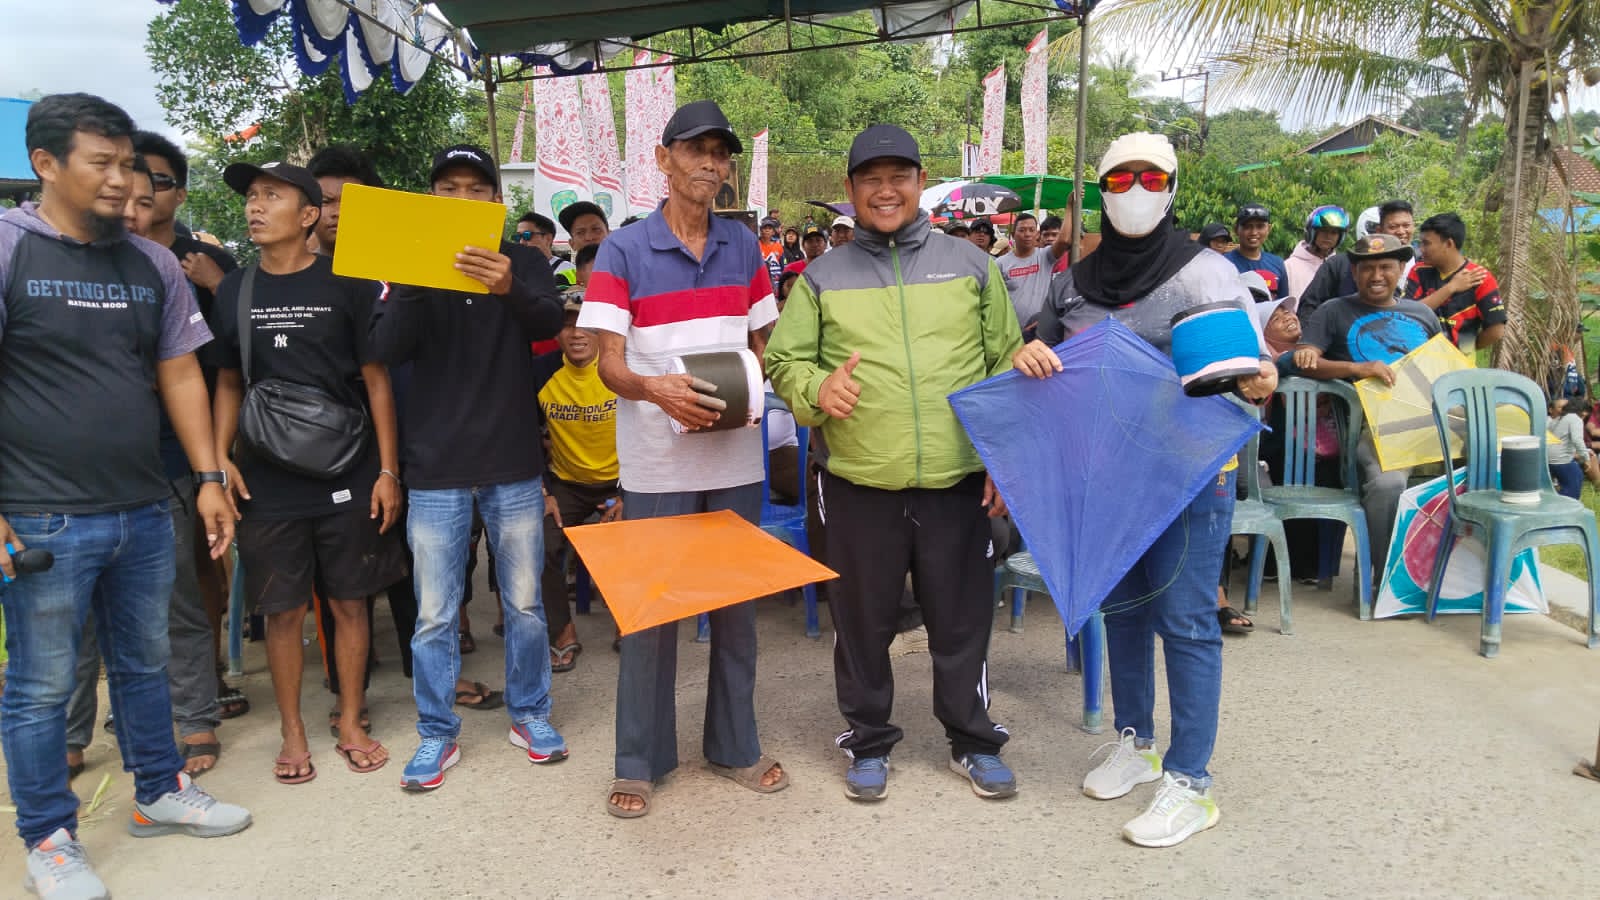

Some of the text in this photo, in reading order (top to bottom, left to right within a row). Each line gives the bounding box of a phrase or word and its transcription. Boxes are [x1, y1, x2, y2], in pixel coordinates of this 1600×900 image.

[27, 279, 105, 301] GETTING
[67, 299, 128, 309] NATURAL MOOD
[549, 411, 580, 421] MADE
